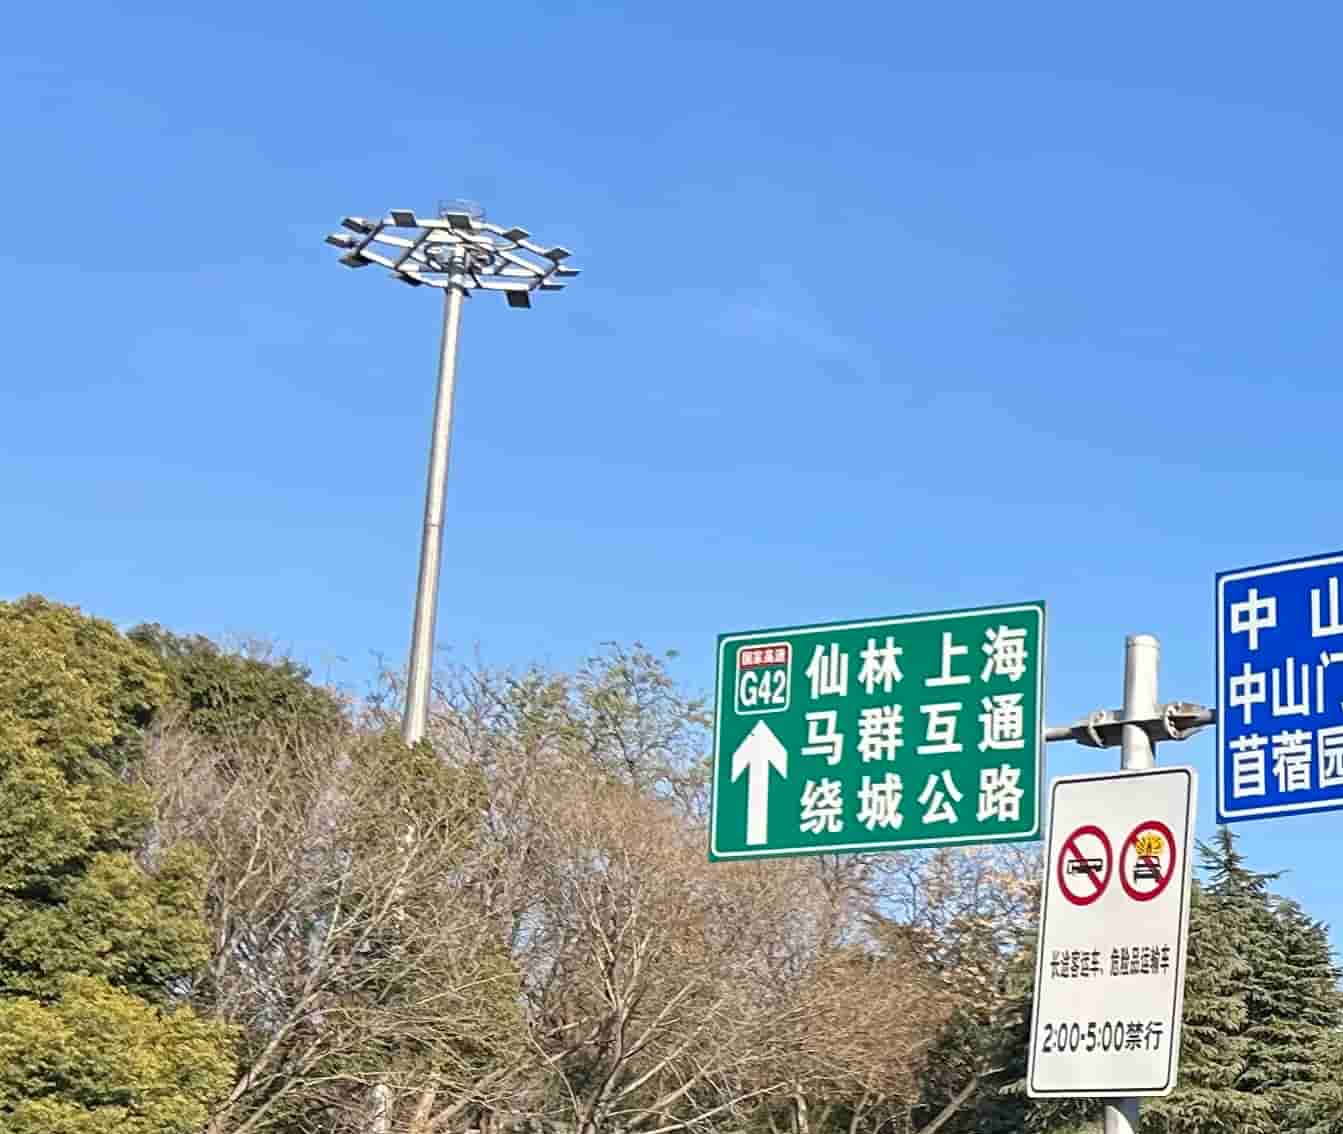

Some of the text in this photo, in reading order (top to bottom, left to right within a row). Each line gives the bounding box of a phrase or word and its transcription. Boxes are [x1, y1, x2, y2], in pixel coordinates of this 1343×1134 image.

[740, 670, 786, 706] G42
[805, 625, 1028, 699] 仙林 上海
[800, 693, 1025, 765] 马群互通
[800, 764, 1025, 834] 绕城公路
